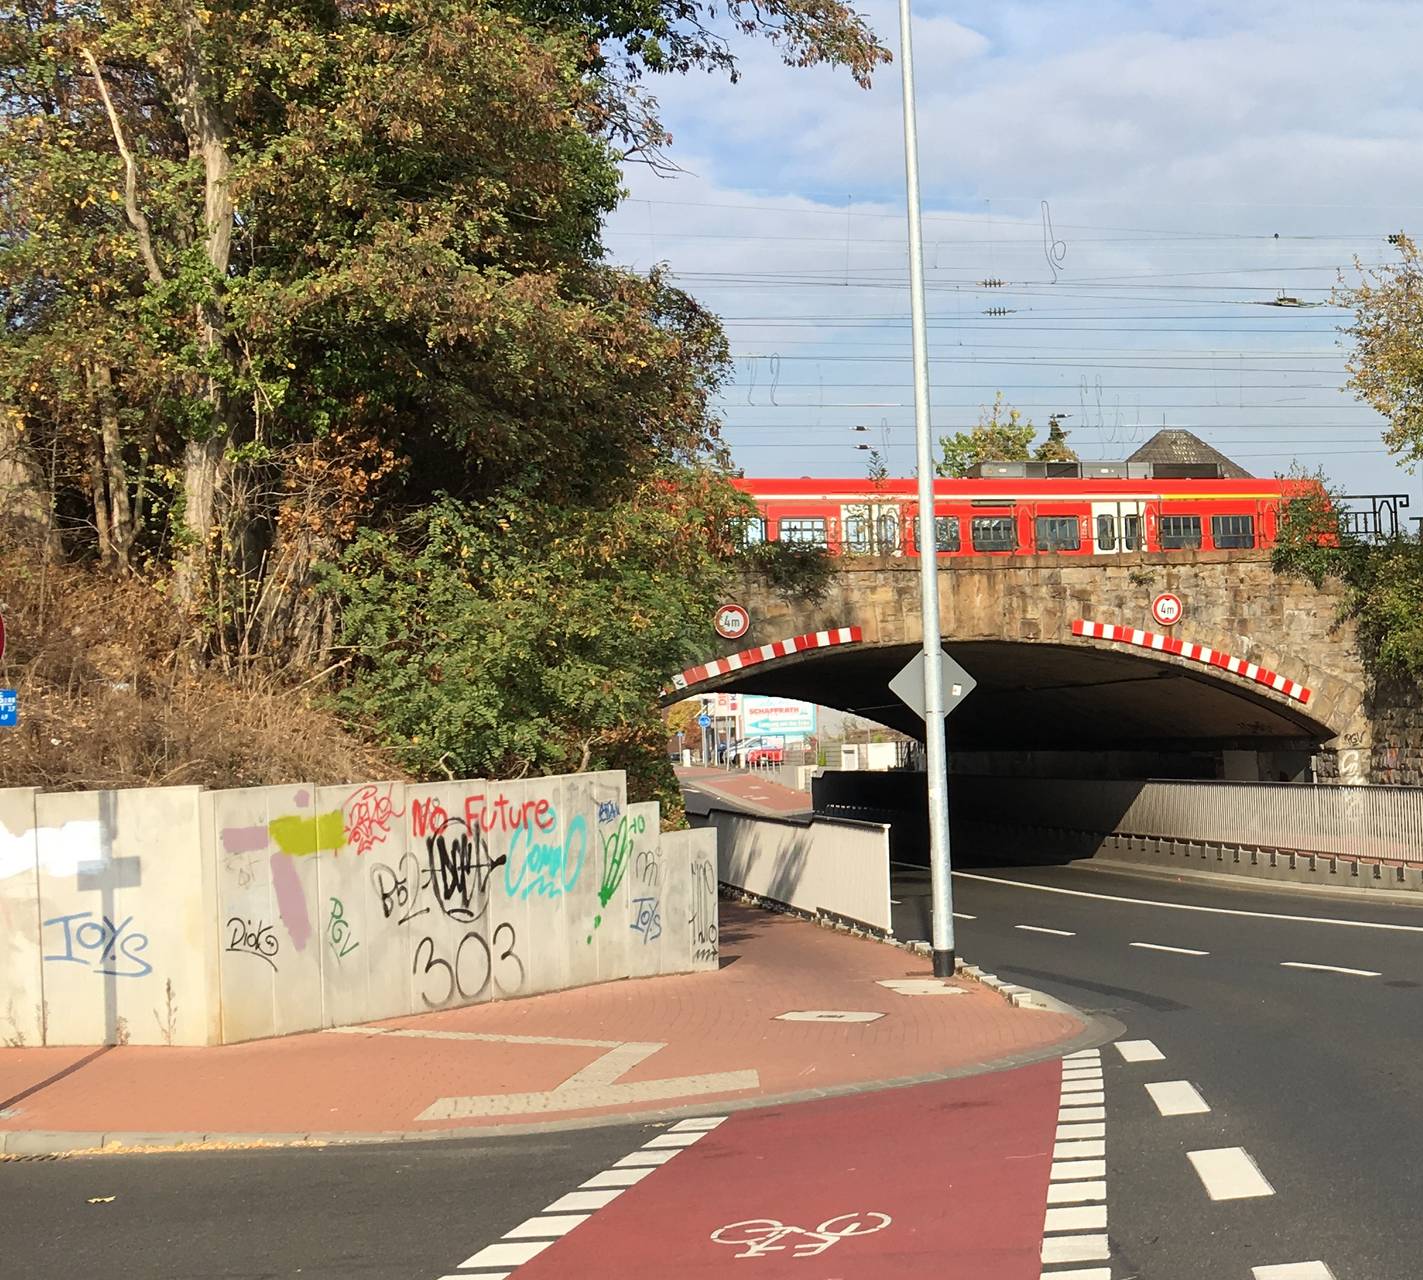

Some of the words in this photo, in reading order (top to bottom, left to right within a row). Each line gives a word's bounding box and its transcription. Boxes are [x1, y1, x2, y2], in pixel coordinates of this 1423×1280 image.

[411, 797, 448, 837] No
[464, 793, 553, 837] Future
[413, 922, 525, 1007] 303
